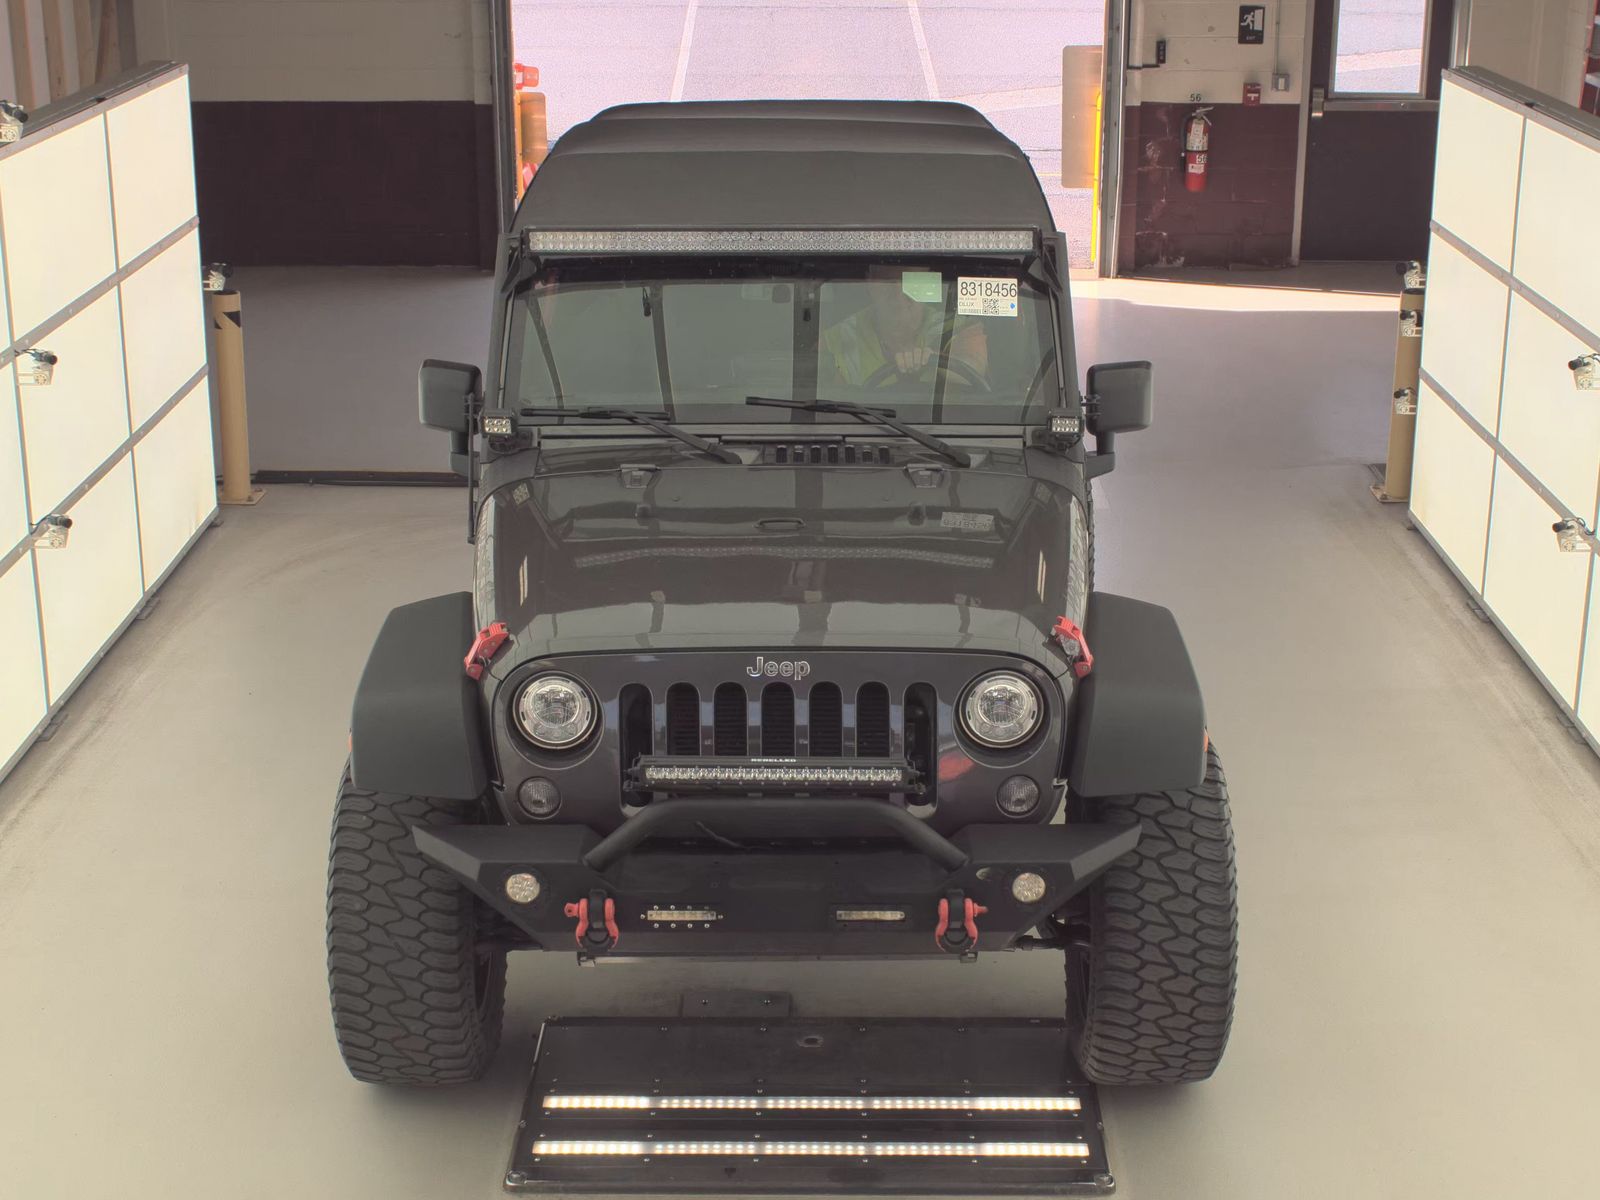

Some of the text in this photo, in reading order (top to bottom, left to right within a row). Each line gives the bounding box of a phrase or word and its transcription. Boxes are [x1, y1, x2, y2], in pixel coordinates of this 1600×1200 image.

[1190, 93, 1202, 102] 56
[960, 281, 1017, 298] 8318456
[746, 656, 811, 681] Jeep
